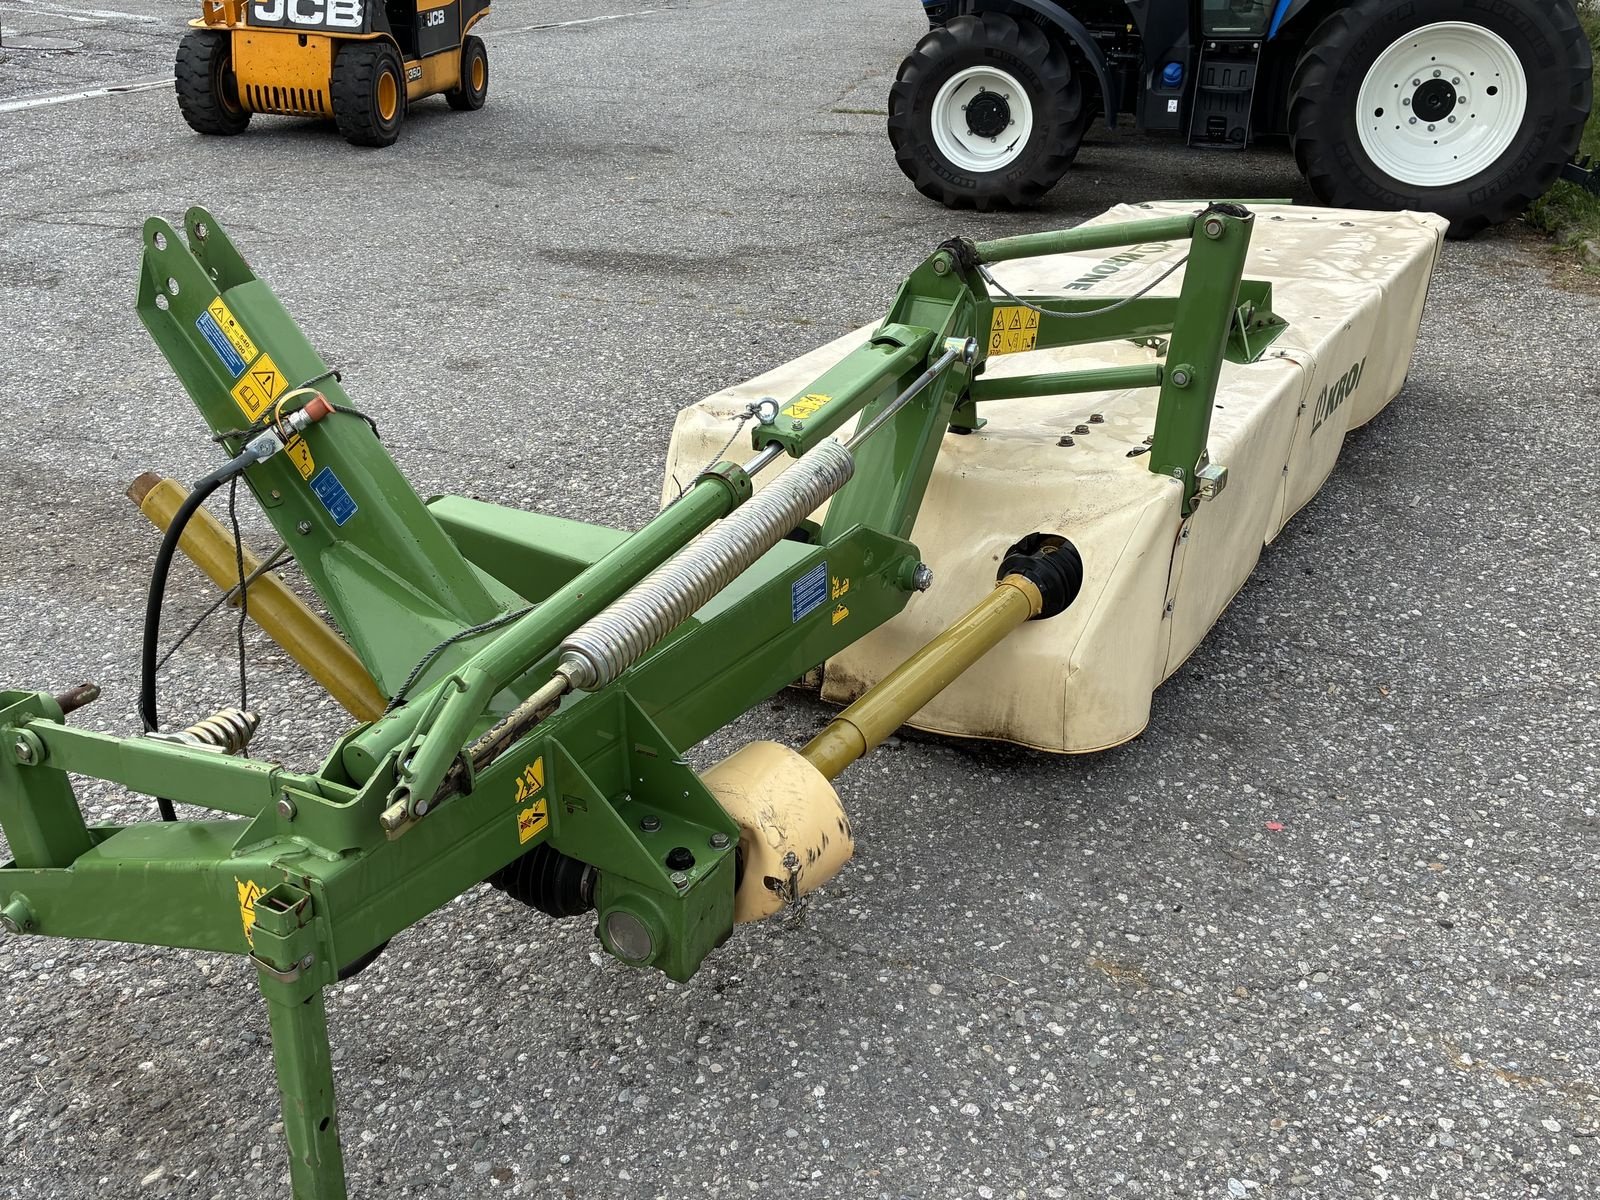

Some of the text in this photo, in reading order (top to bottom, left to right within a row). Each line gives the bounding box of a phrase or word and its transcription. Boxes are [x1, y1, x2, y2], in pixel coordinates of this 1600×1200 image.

[254, 0, 363, 27] JCB
[427, 9, 445, 27] JCB
[1063, 252, 1146, 291] KRONE
